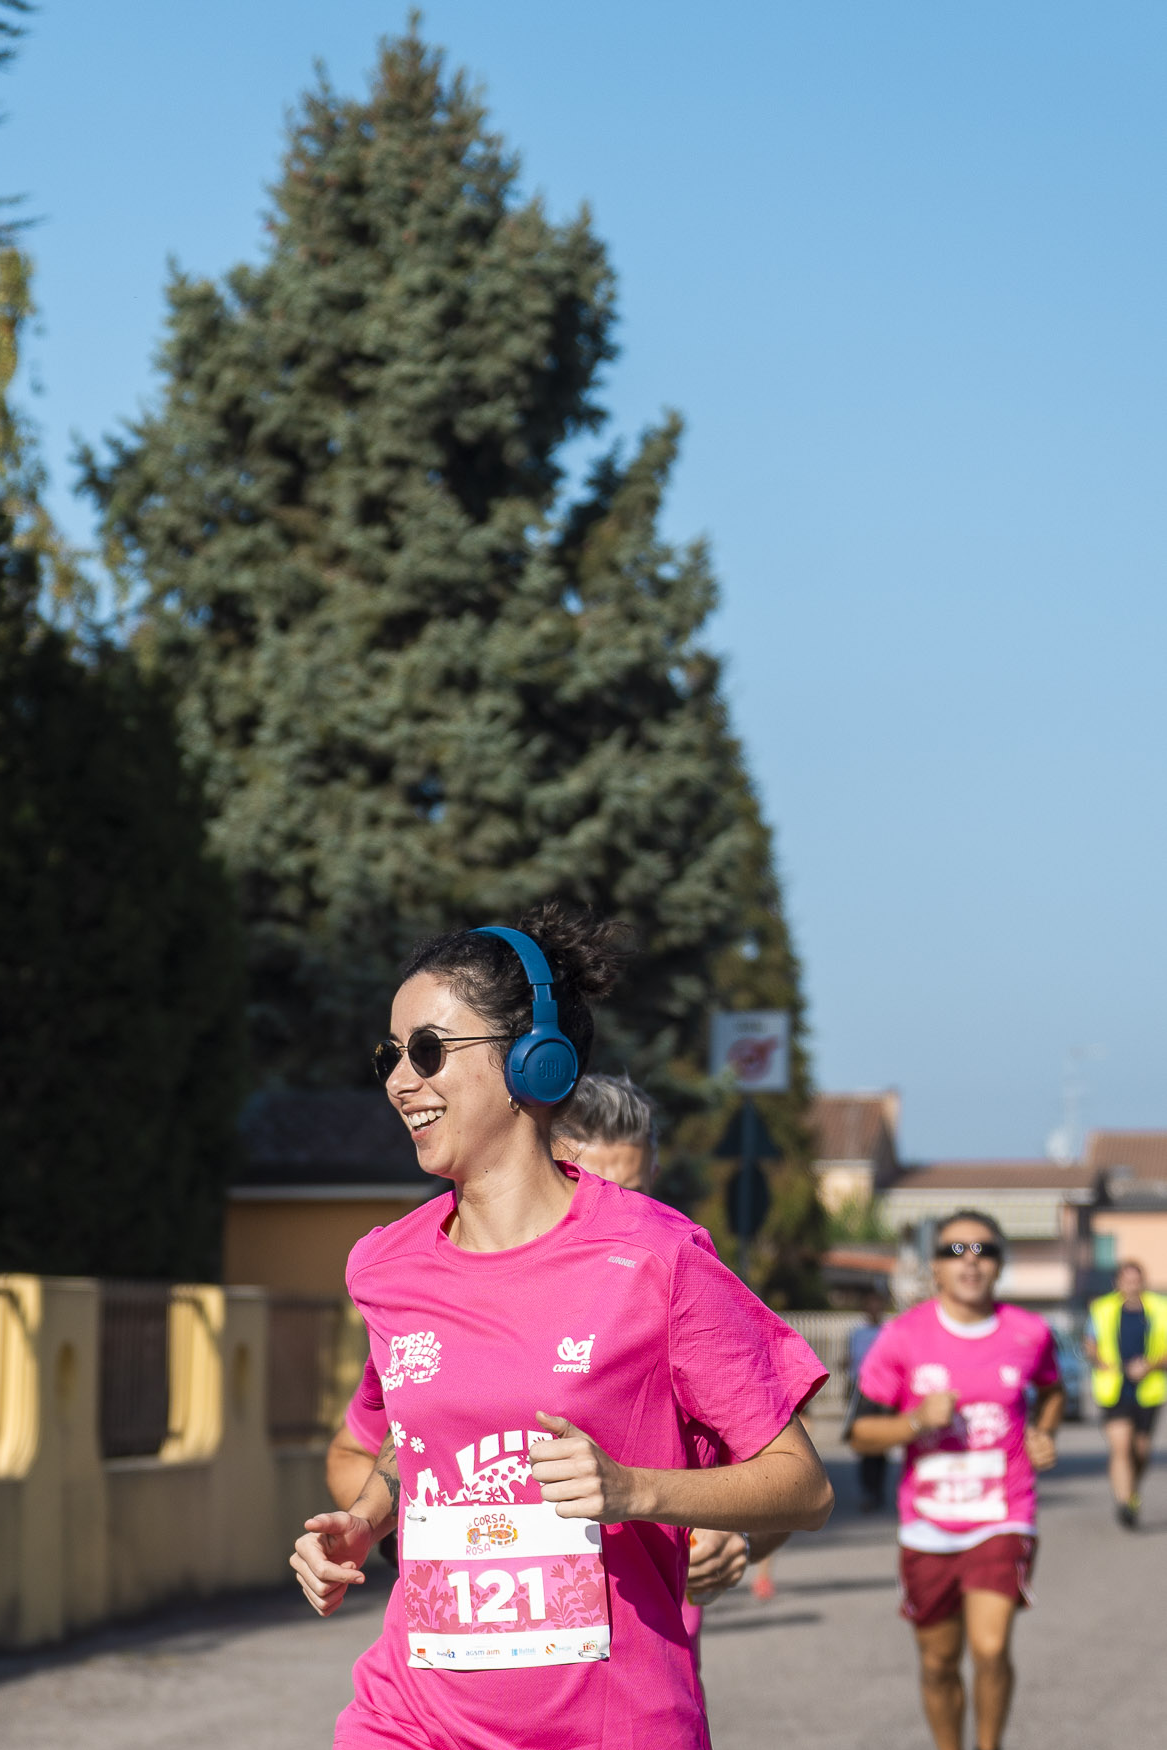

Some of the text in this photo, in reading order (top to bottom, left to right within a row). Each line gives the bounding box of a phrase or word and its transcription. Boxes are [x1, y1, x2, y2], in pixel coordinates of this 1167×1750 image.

[538, 1059, 565, 1079] JBL
[391, 1331, 435, 1351] CORSA
[552, 1363, 591, 1374] correre
[474, 1513, 506, 1527] CORSA
[465, 1542, 491, 1556] ROSA
[447, 1566, 547, 1625] 121
